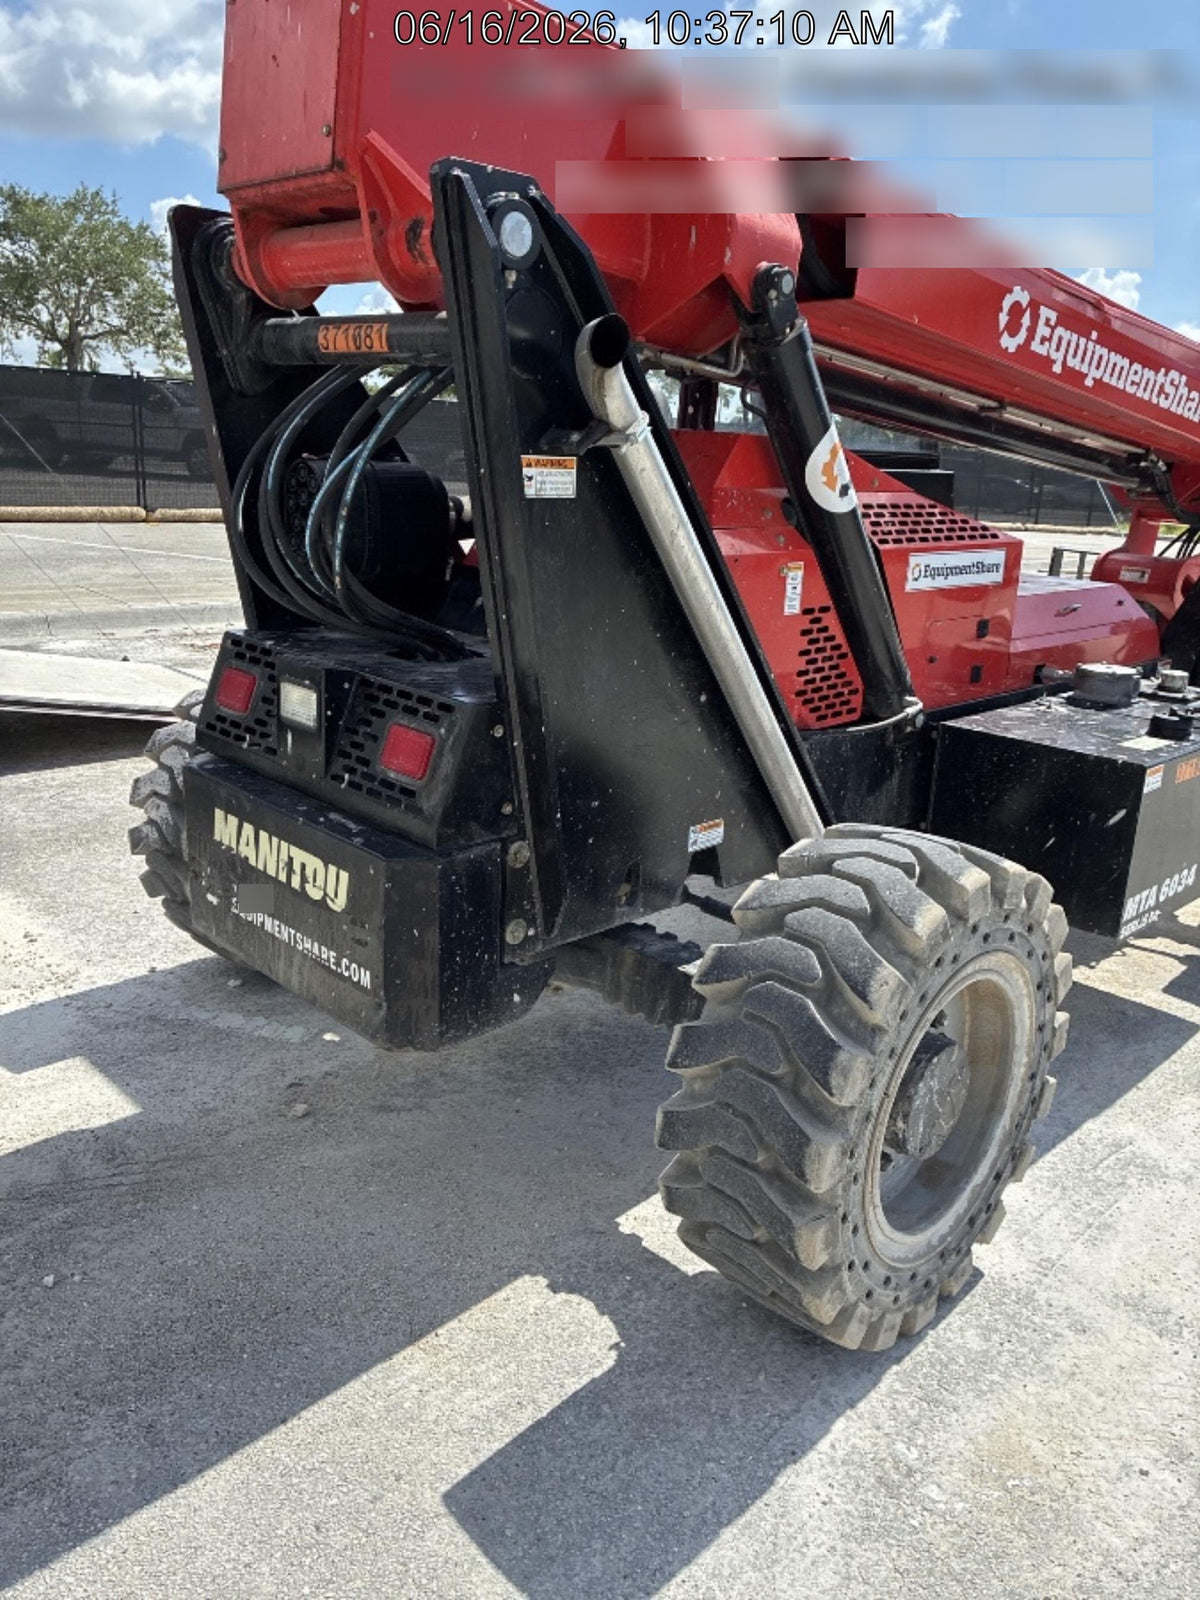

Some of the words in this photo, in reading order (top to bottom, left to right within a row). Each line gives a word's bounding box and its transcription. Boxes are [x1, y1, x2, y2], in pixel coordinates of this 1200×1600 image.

[923, 561, 1002, 580] EquipmentShare
[213, 807, 349, 912] MANITOU
[1121, 884, 1158, 923] MTA
[1158, 863, 1198, 902] 6034
